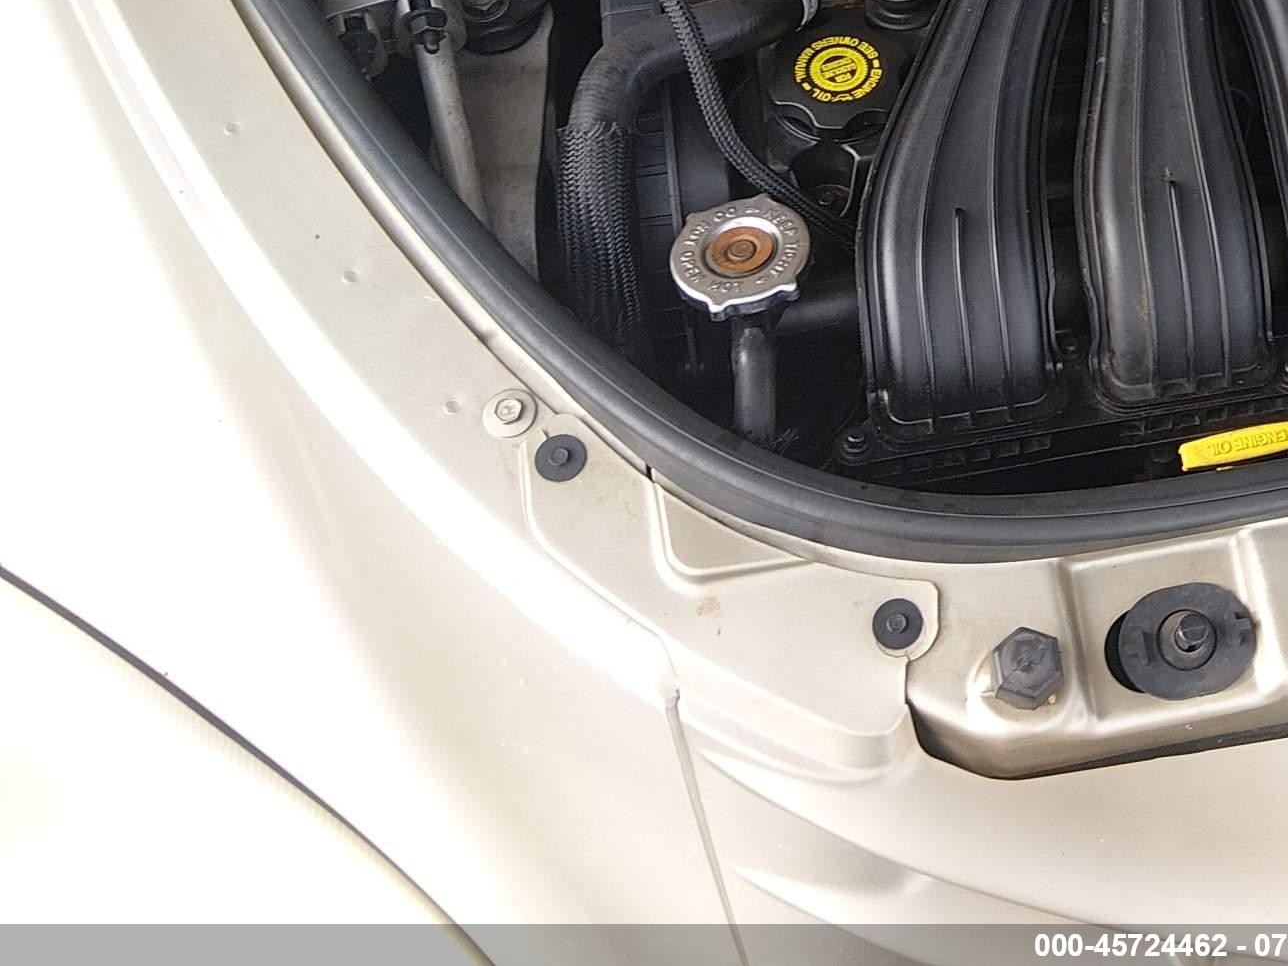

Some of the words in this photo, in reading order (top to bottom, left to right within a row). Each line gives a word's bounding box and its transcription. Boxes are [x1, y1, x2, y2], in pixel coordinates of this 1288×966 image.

[811, 36, 859, 51] OWNERS
[857, 41, 879, 59] SEE
[794, 47, 816, 84] MANUAL
[811, 88, 832, 102] OIL
[850, 68, 883, 100] ENGINE
[763, 208, 798, 237] KEEP
